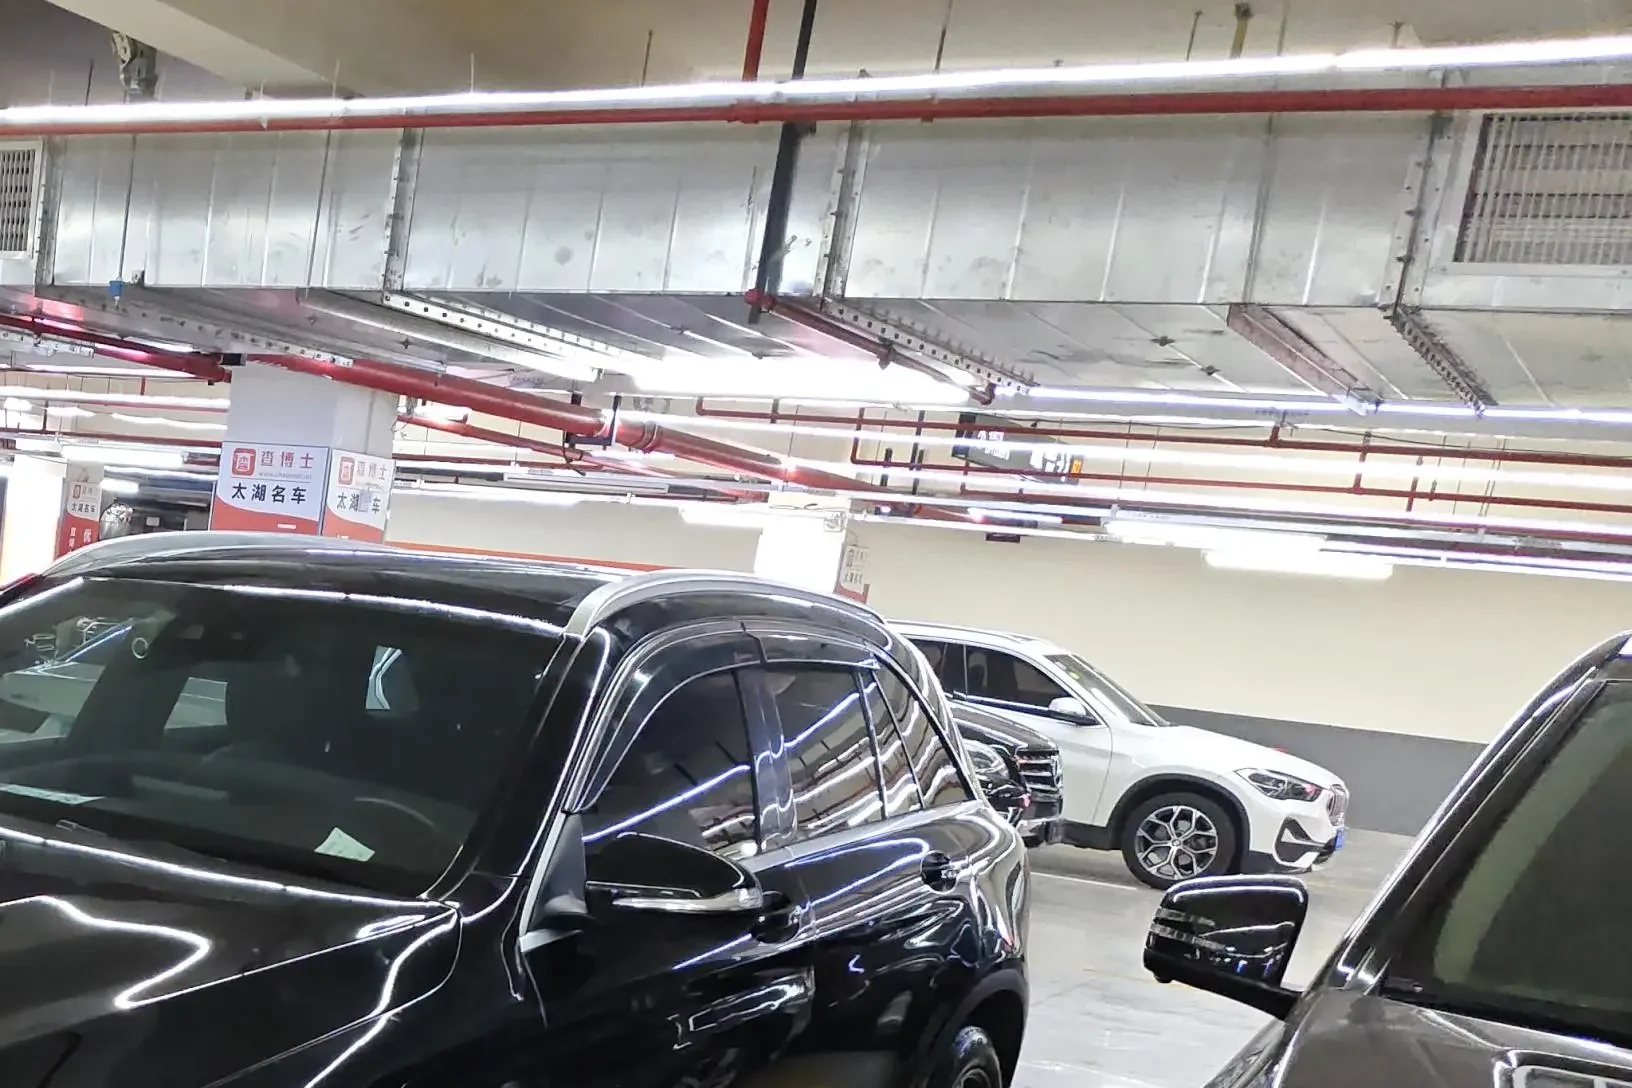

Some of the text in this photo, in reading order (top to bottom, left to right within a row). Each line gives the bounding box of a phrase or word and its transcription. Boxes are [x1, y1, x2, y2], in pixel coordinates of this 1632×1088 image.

[260, 450, 314, 469] 查博士
[231, 482, 307, 505] 太湖名车
[336, 491, 382, 514] 太湖车
